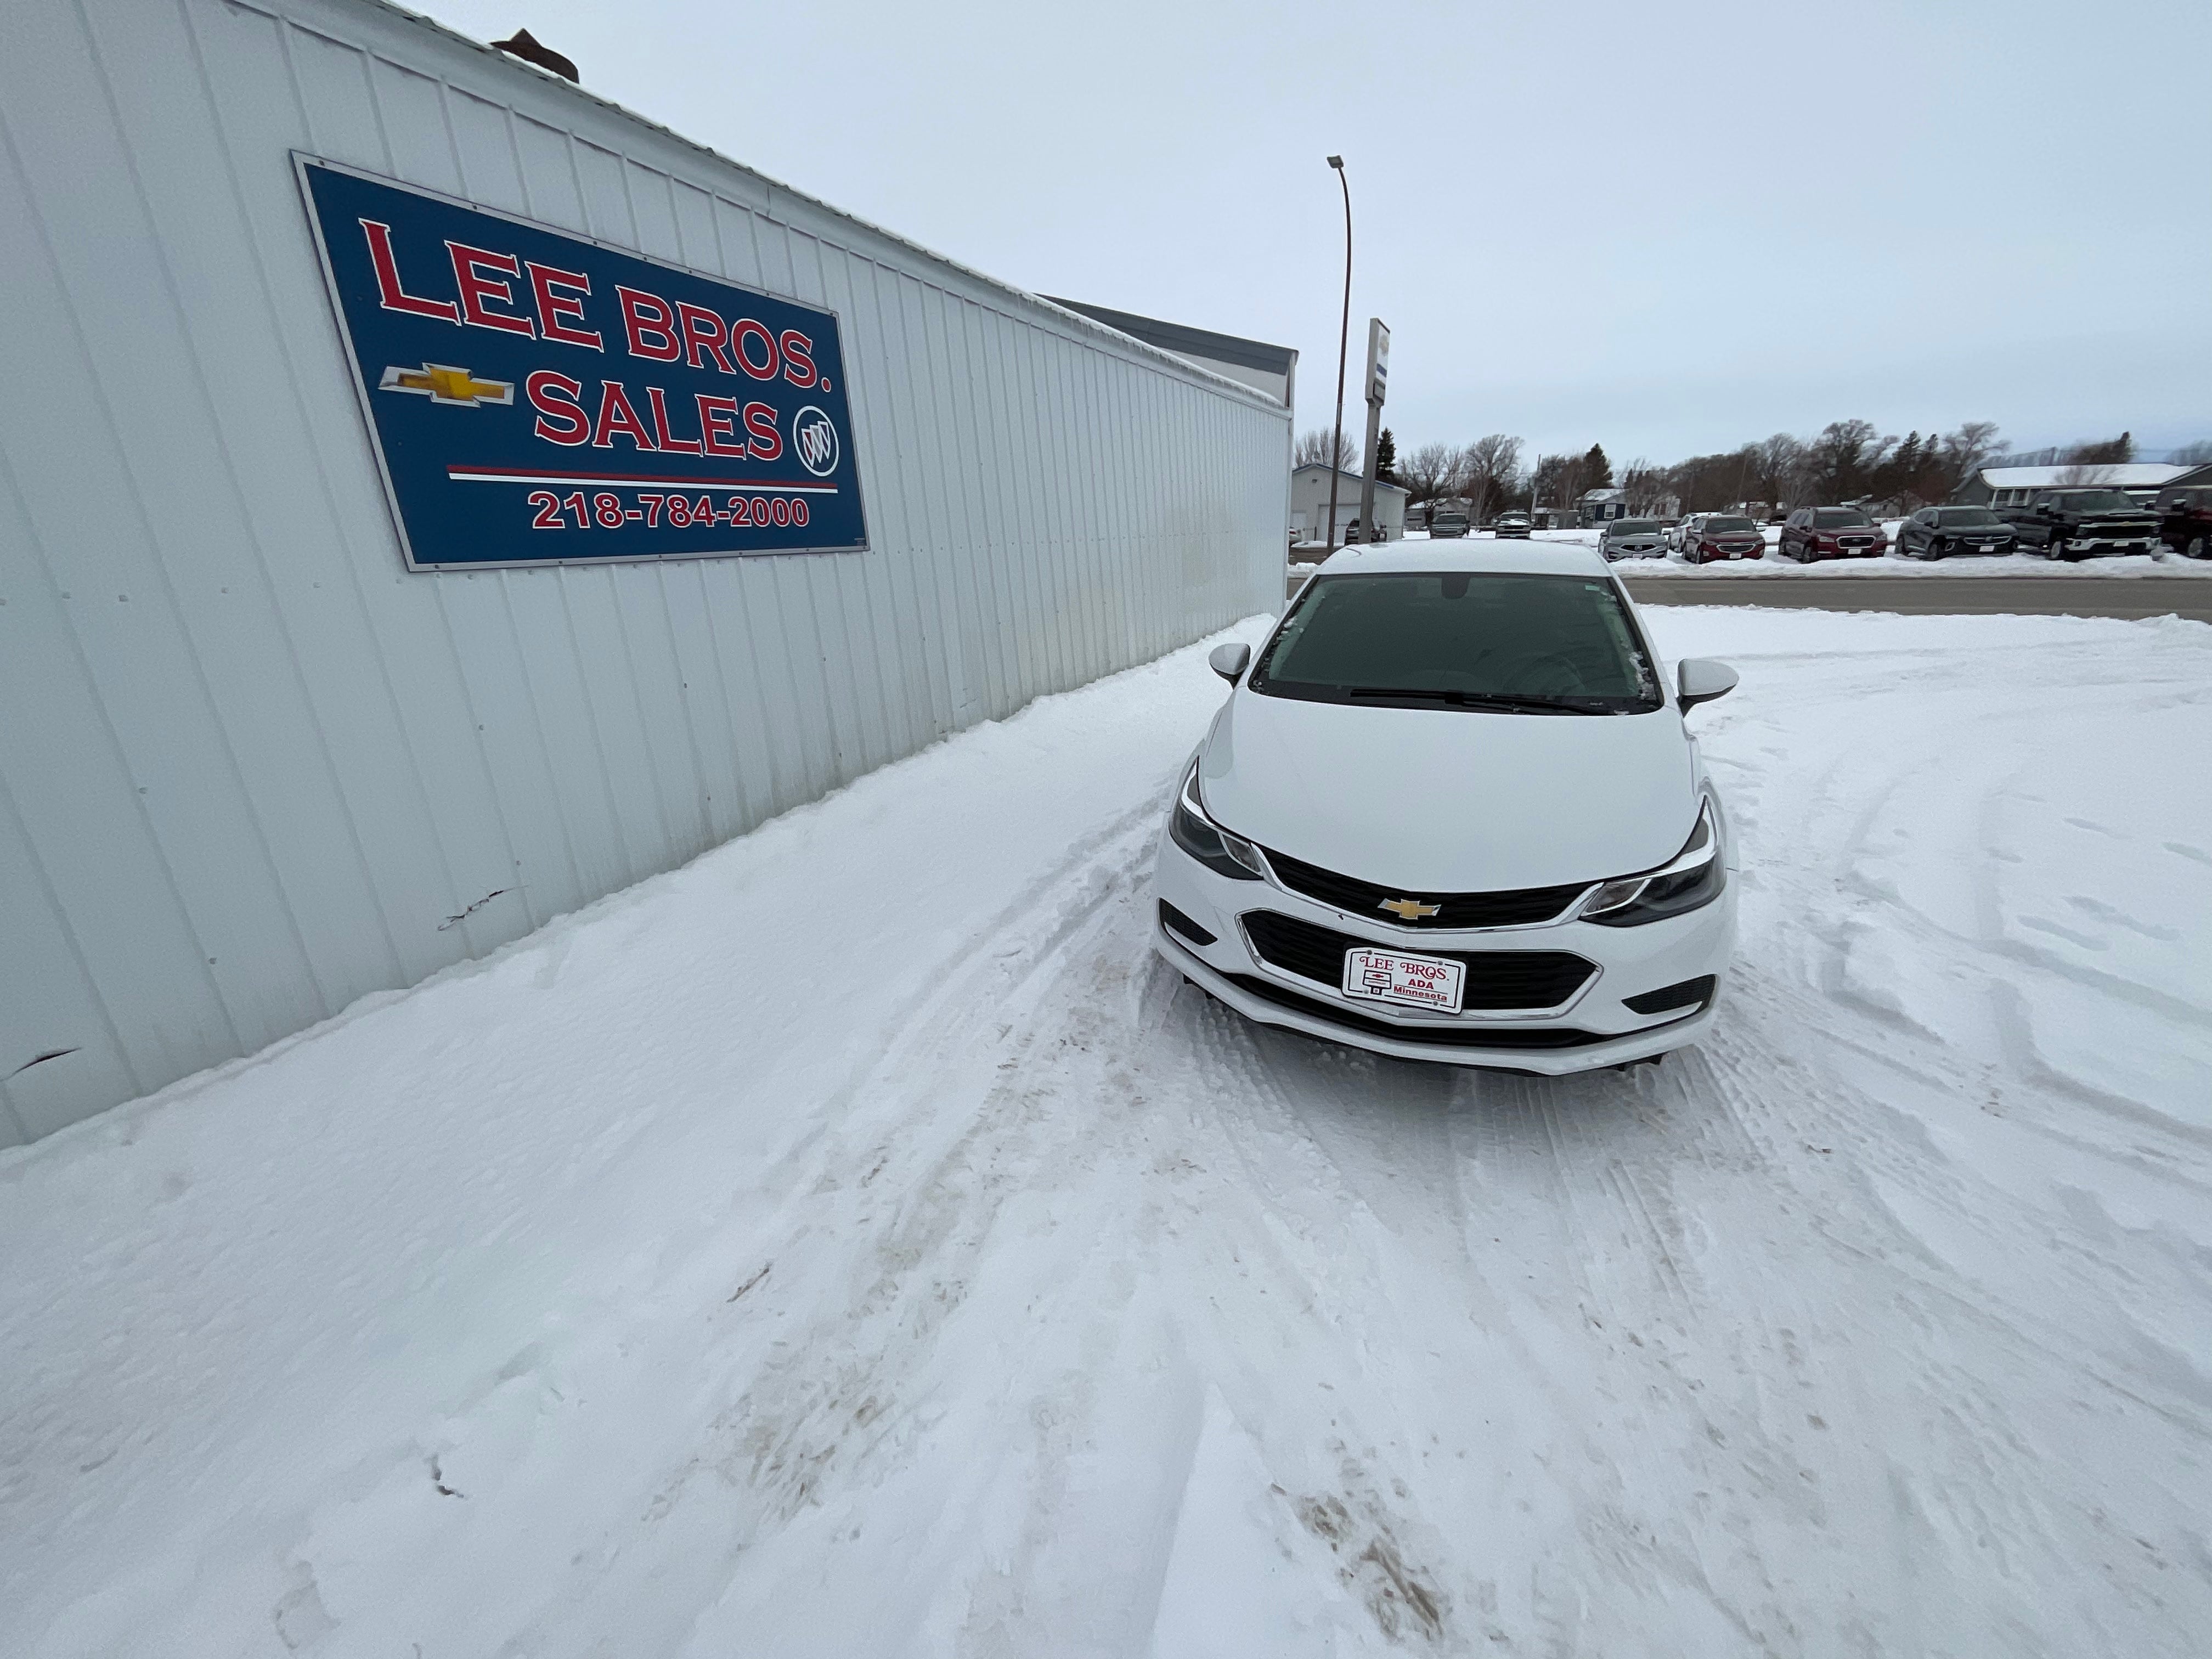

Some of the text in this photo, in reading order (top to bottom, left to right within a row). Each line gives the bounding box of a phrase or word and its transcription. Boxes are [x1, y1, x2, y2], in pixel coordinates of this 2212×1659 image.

[358, 217, 831, 392] LEE BROS.
[526, 370, 783, 461] SALES
[528, 490, 809, 529] 218-784-2000
[1359, 956, 1394, 970] LEE
[1393, 985, 1447, 1001] Minnesota
[1408, 978, 1435, 990] ADA
